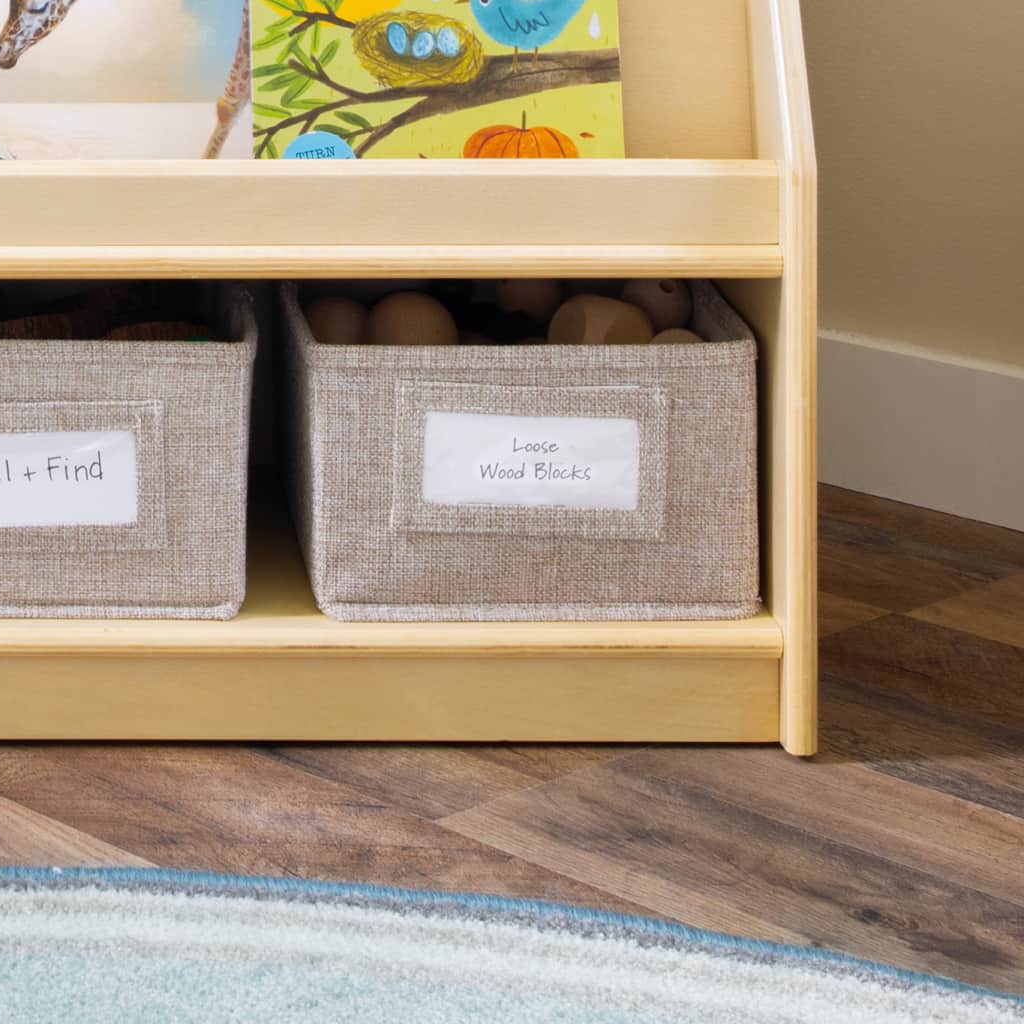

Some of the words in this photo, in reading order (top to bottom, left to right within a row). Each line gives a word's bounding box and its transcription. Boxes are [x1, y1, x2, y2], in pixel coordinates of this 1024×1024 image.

[296, 145, 336, 160] TURN
[512, 436, 560, 454] Loose
[23, 465, 37, 482] +
[47, 450, 104, 482] Find
[479, 462, 526, 481] Wood
[534, 462, 592, 481] Blocks
